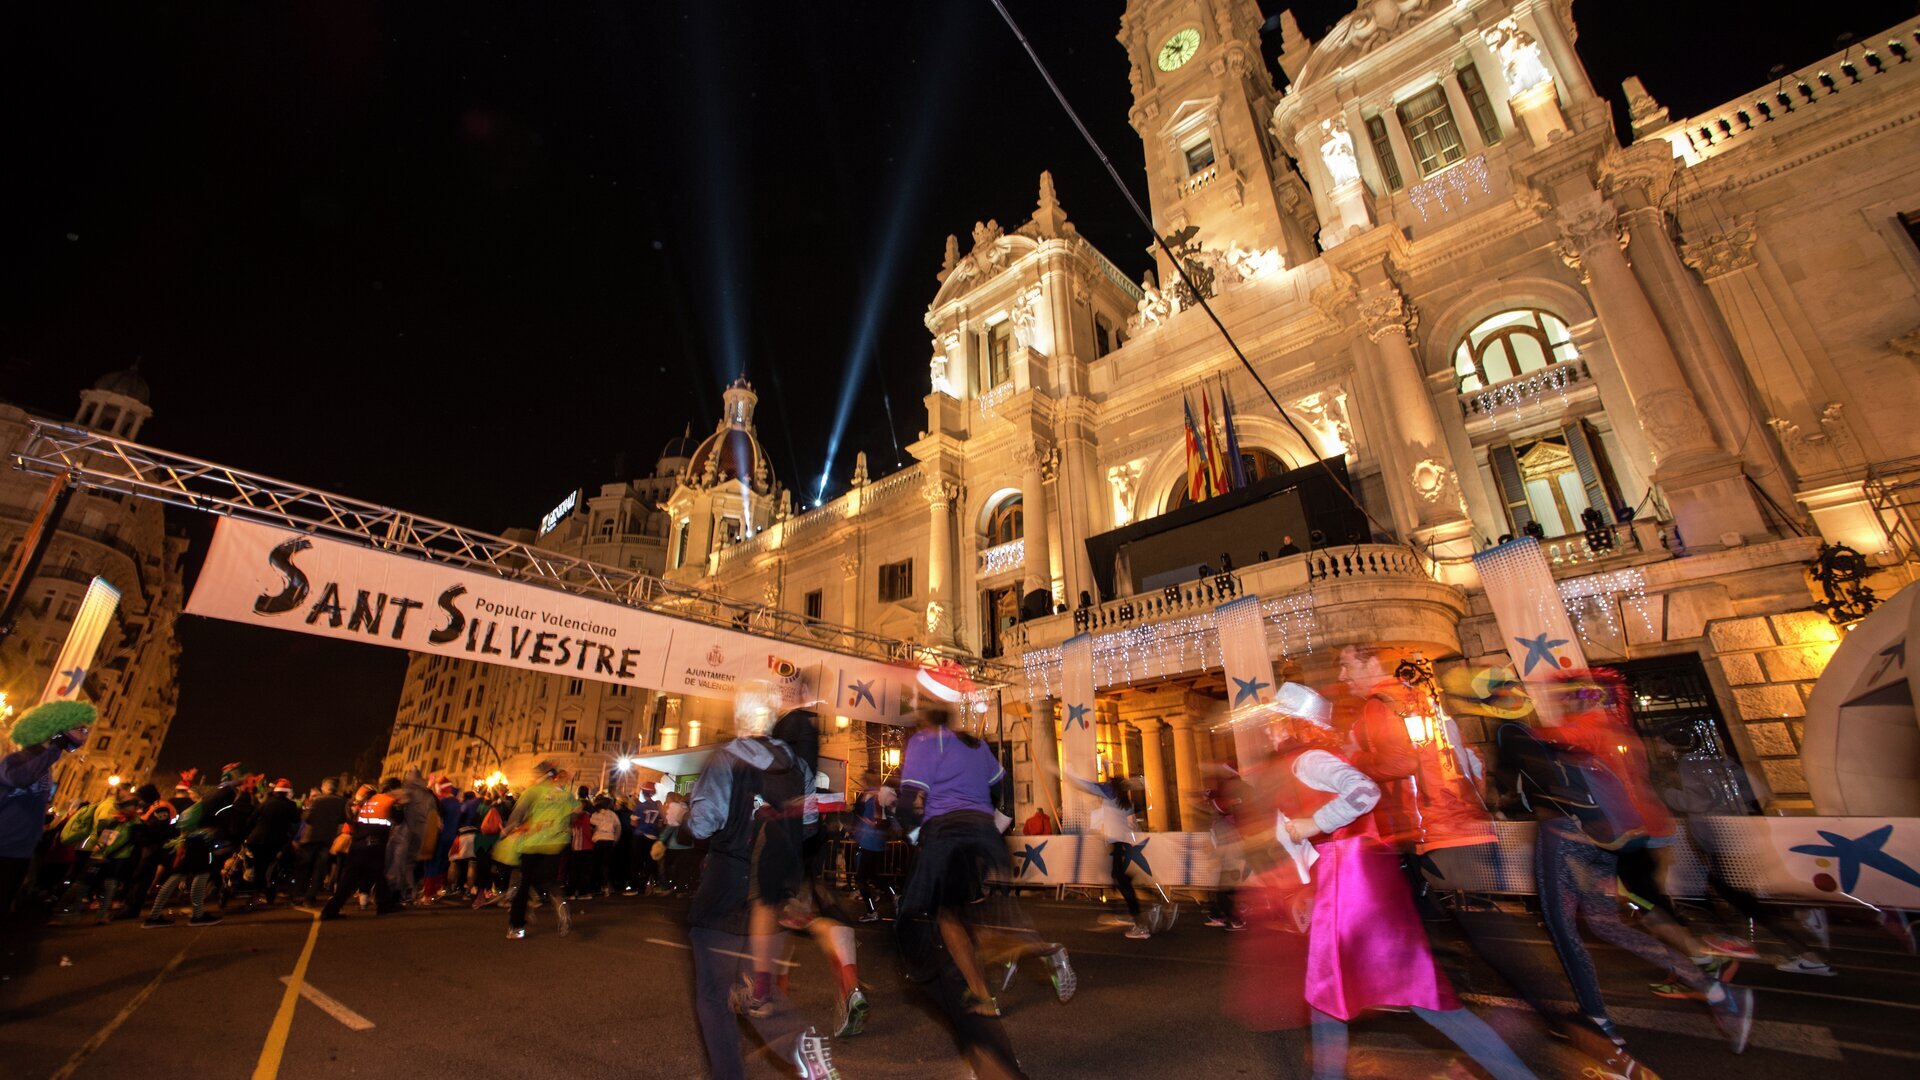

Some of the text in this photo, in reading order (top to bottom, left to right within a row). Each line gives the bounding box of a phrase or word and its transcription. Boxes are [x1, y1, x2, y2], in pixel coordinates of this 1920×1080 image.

[252, 535, 641, 679] SANT SILVESTRE
[475, 597, 617, 638] Popular Valenciana
[684, 677, 696, 686] DE
[685, 667, 736, 682] AJUNTAMENT
[643, 809, 660, 824] 17
